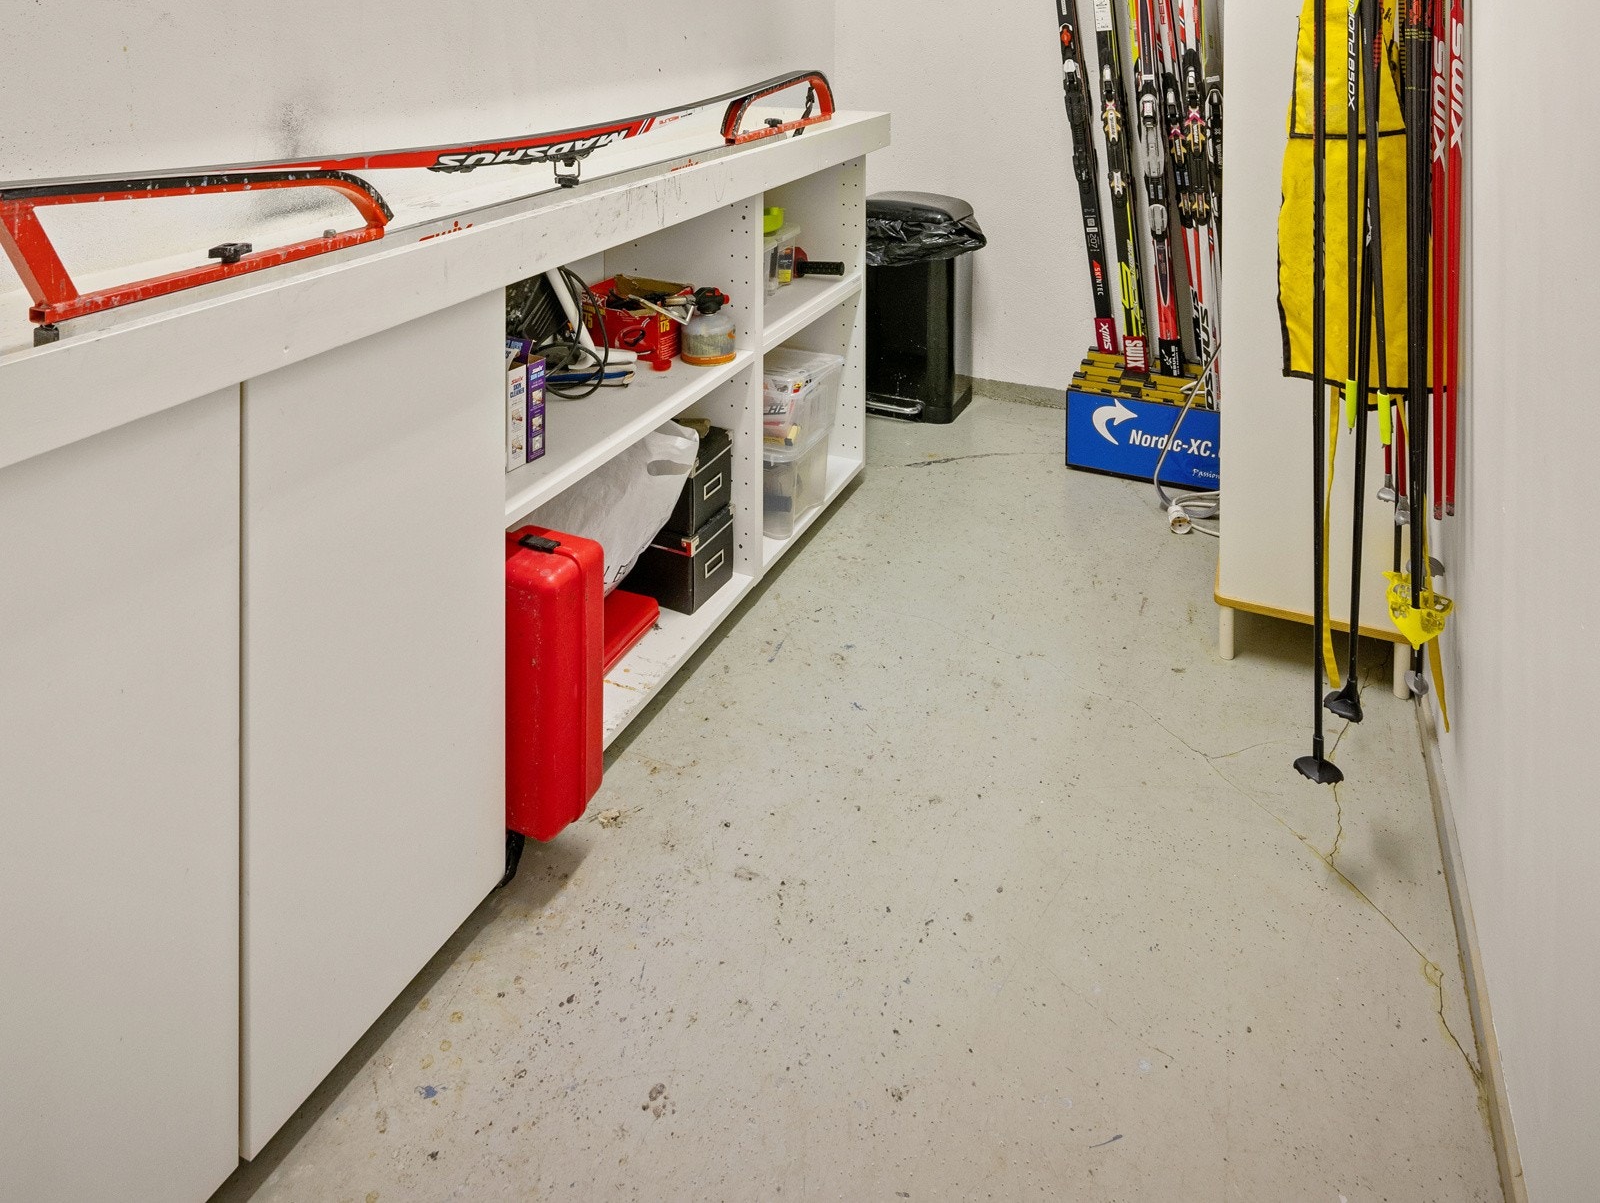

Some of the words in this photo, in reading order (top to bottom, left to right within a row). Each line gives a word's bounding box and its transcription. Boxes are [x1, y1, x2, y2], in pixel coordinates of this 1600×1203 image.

[1450, 17, 1464, 158] SWIX
[1433, 36, 1446, 172] SWIX
[437, 129, 629, 167] MADSHUS
[1089, 233, 1098, 248] 207
[1092, 267, 1105, 296] SKINTEC
[1099, 322, 1112, 351] SWIX
[1125, 339, 1145, 369] SWIX
